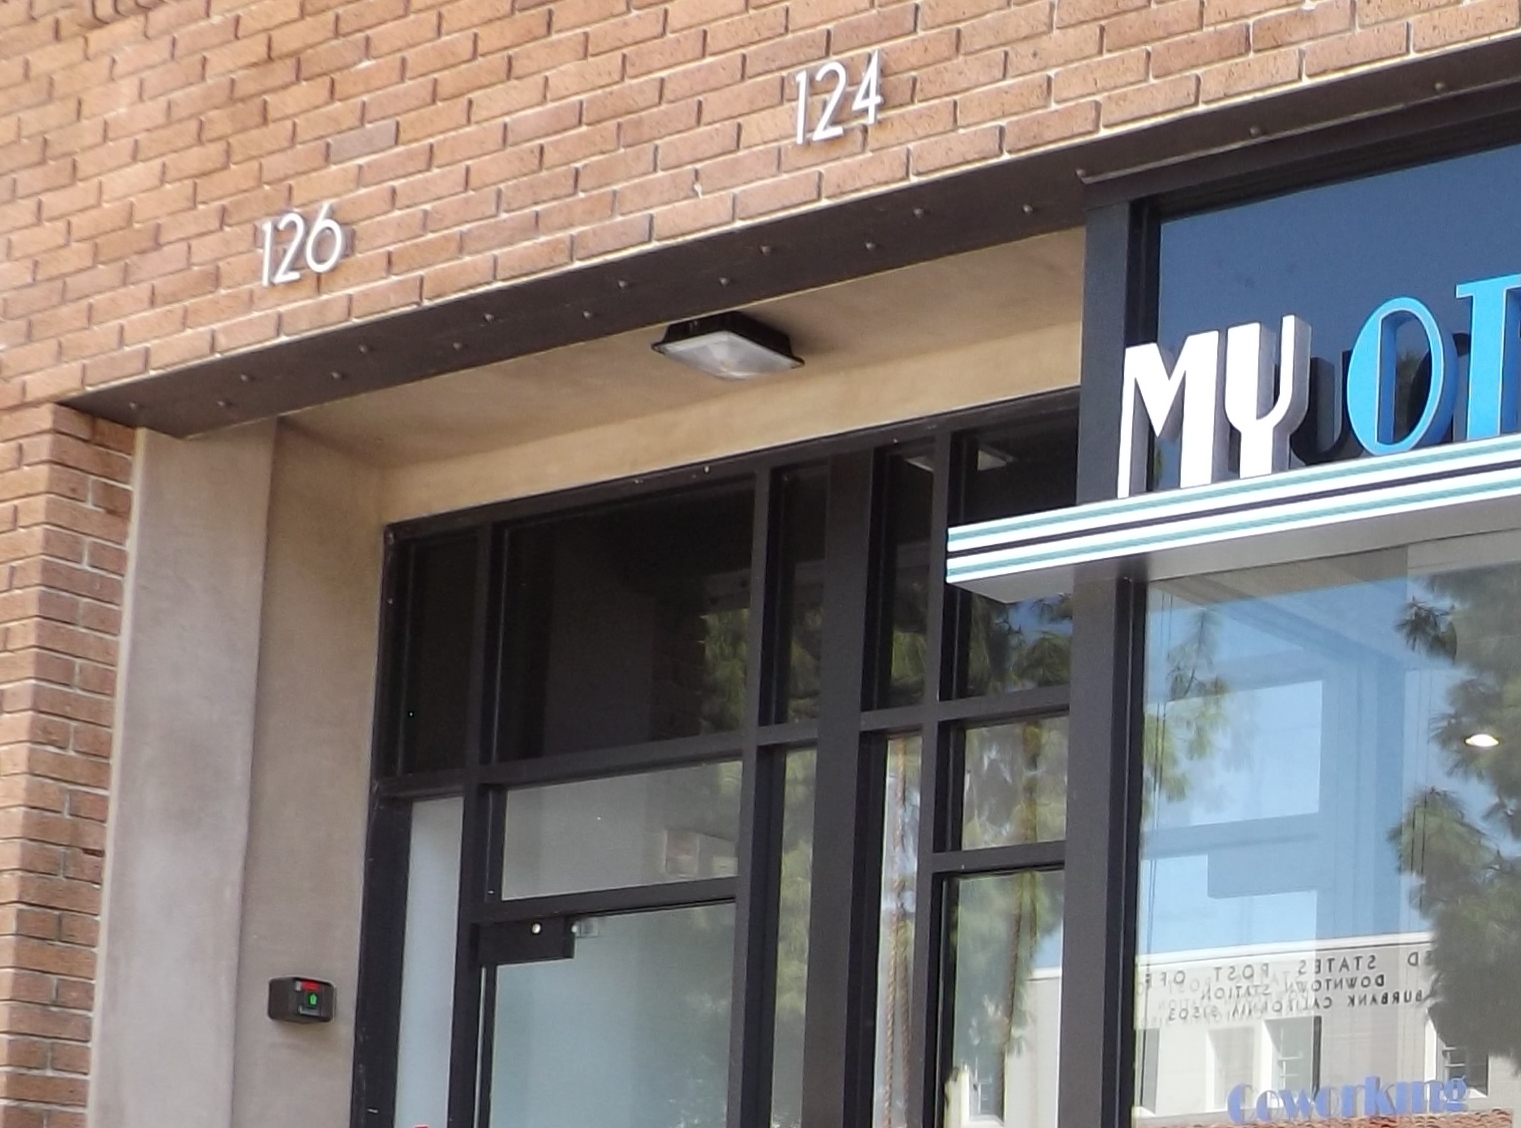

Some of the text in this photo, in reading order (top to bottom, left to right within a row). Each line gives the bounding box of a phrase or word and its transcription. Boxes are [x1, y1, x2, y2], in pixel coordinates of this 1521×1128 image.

[795, 52, 884, 146] 124
[259, 204, 347, 286] 126
[1117, 314, 1311, 498] MY
[1227, 1075, 1469, 1125] Coworking
